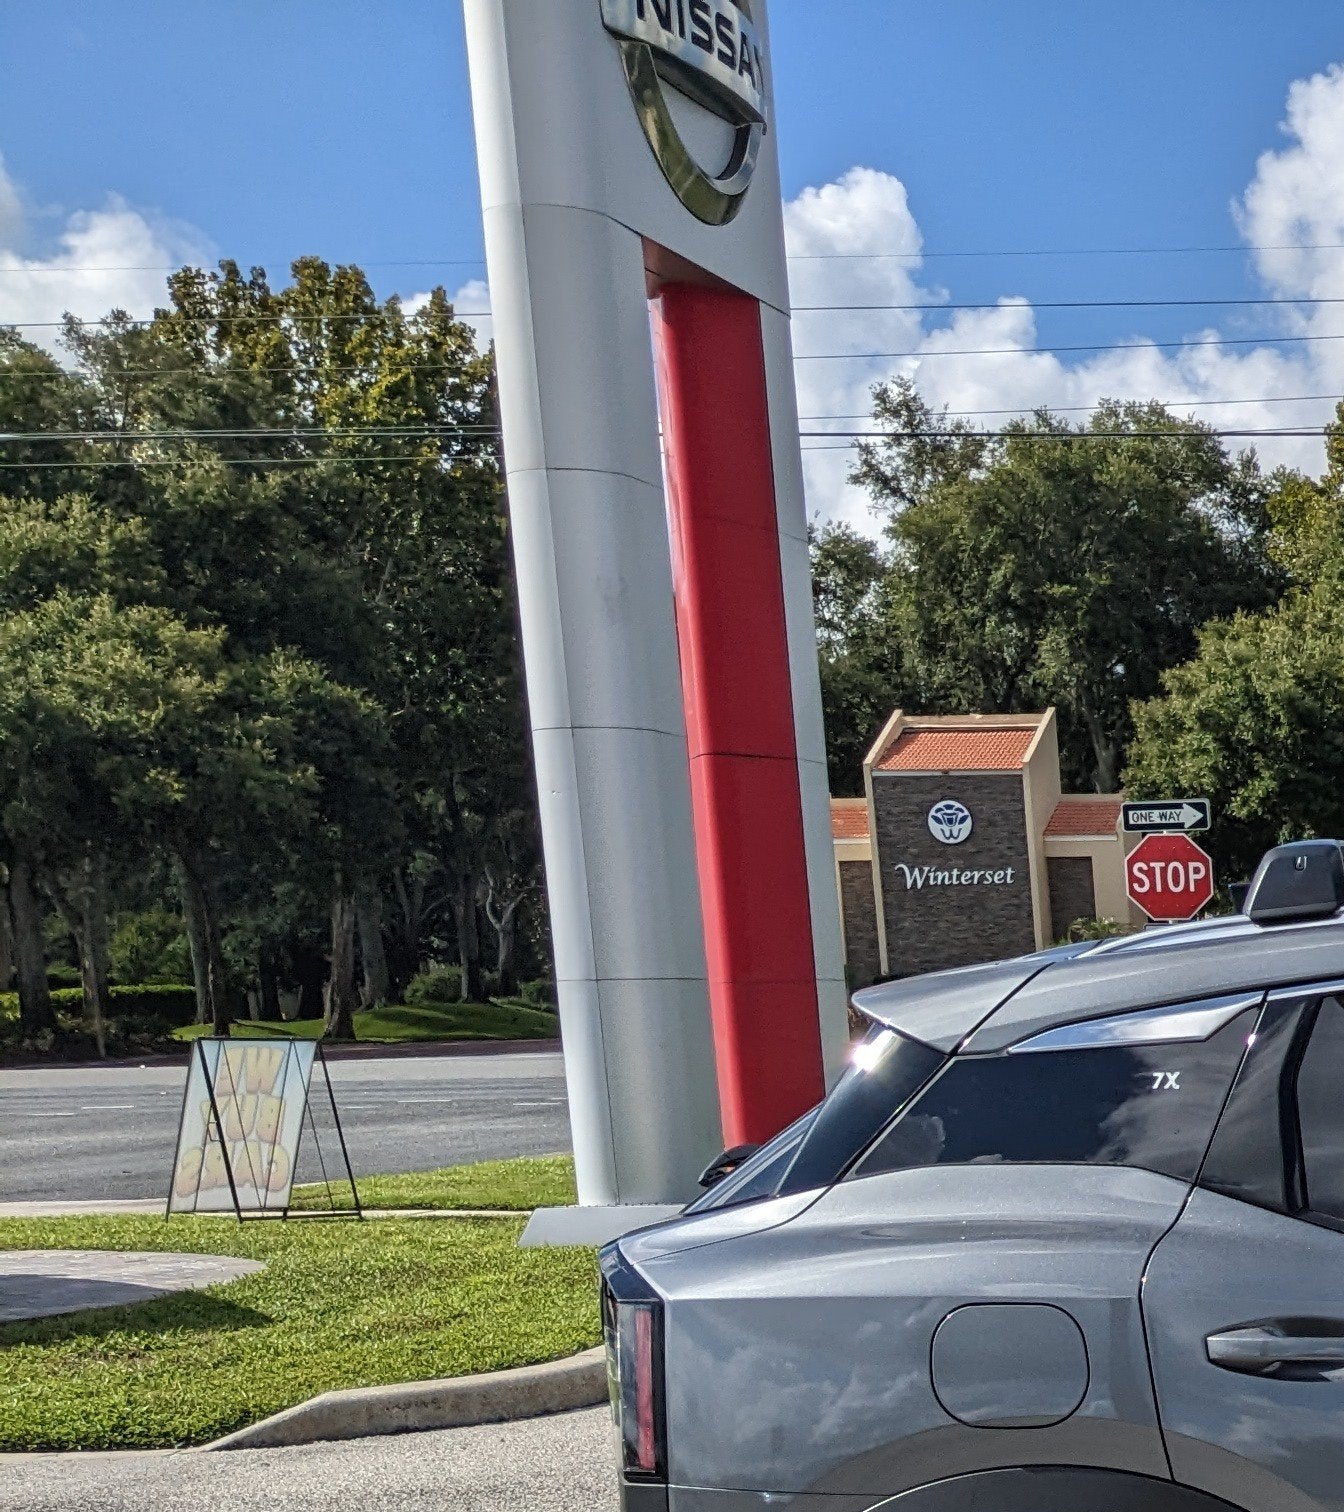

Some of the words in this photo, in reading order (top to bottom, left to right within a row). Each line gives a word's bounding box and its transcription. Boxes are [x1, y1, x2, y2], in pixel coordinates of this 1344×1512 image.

[1131, 811, 1154, 823] ONE
[1158, 811, 1182, 822] WAY
[894, 863, 1016, 890] Winterset
[1132, 861, 1206, 893] STOP
